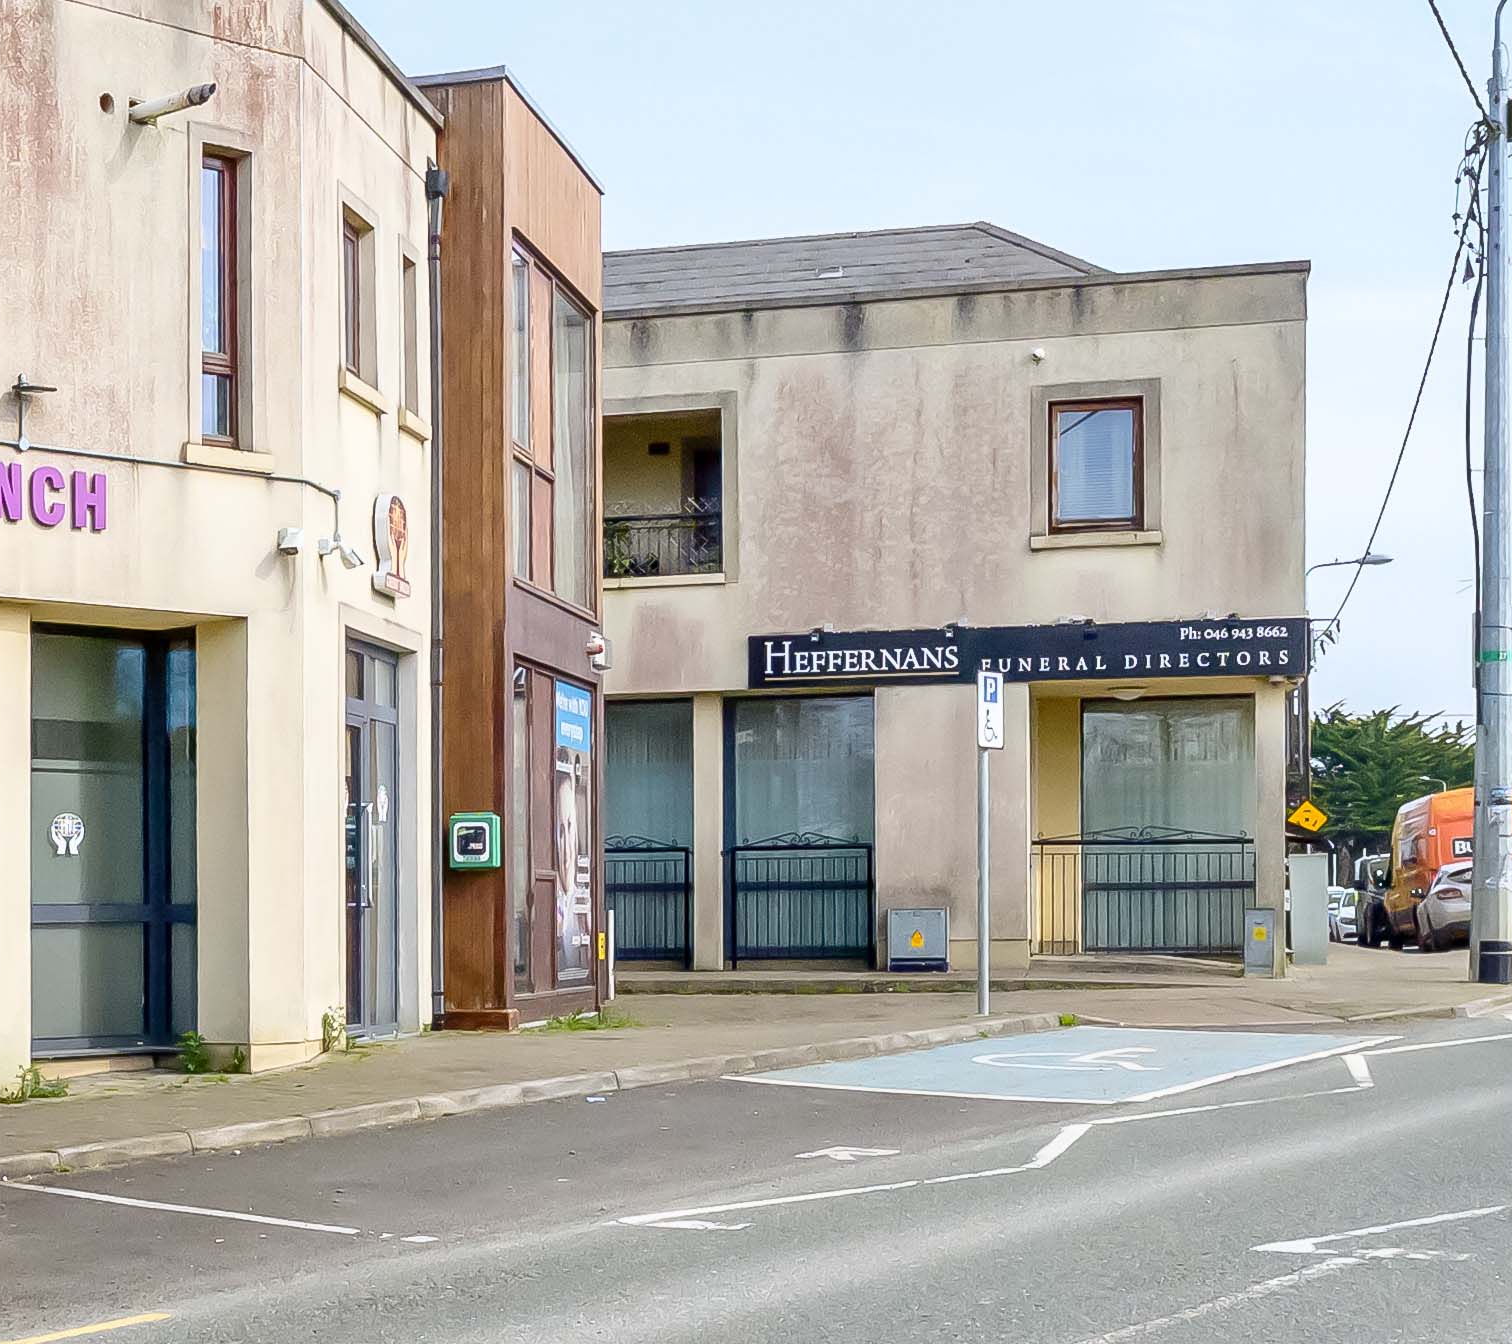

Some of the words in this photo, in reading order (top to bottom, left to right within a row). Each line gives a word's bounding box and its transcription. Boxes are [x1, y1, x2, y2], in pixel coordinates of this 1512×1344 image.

[1180, 627, 1201, 640] Ph:
[1204, 629, 1227, 640] 046
[1231, 628, 1253, 639] 943
[1256, 626, 1288, 638] 8662
[764, 641, 959, 674] HEFFERNANS
[981, 655, 1106, 673] FUNERAL
[1124, 649, 1289, 670] DIRECTORS
[986, 681, 996, 702] P
